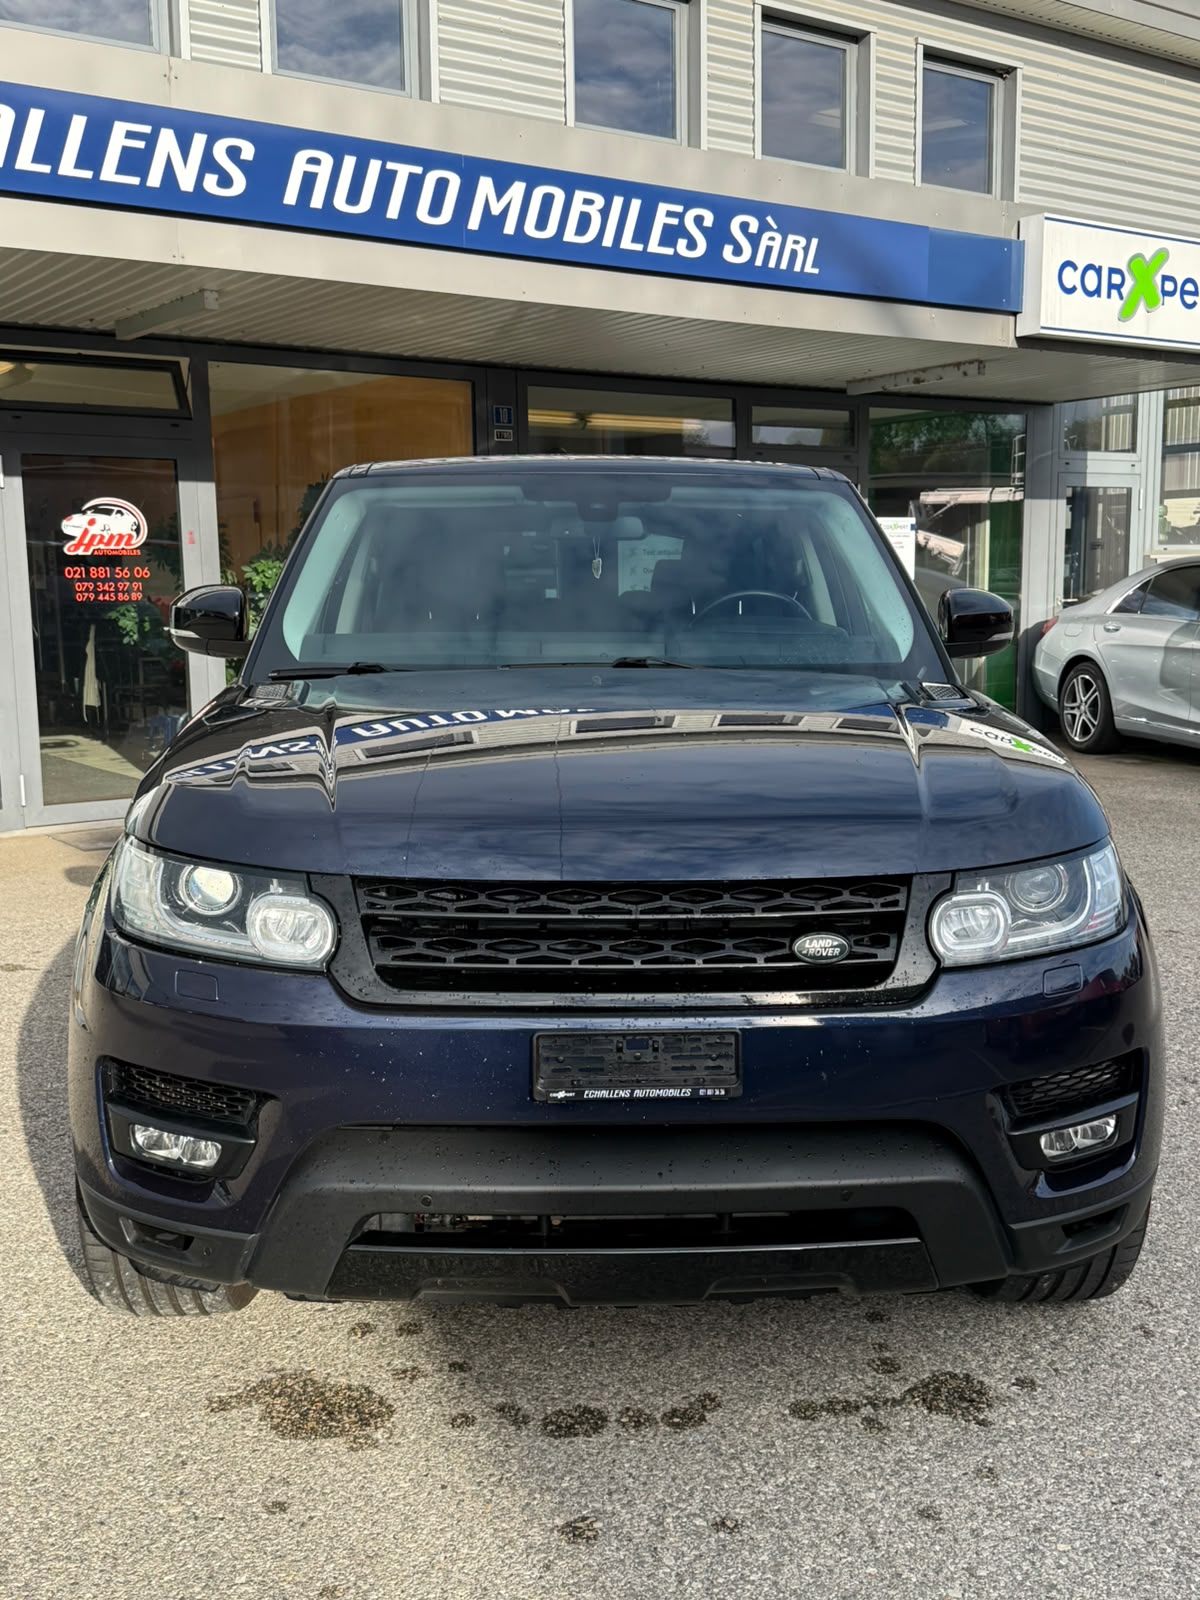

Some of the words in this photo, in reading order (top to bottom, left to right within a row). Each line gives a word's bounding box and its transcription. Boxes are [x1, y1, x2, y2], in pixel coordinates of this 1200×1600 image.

[64, 567, 86, 579] 021
[89, 567, 110, 579] 881
[114, 567, 130, 579] 56
[134, 567, 150, 579] 06
[75, 582, 94, 592] 079
[96, 582, 115, 592] 342
[117, 582, 130, 592] 97
[132, 582, 143, 592] 91
[76, 592, 95, 602] 079
[98, 592, 116, 602] 445
[117, 592, 129, 602] 86
[131, 592, 143, 602] 89
[805, 939, 833, 948] LAND
[807, 947, 841, 957] ROVER
[583, 1089, 631, 1099] ECHALLENS
[634, 1088, 692, 1098] AUTOMOBILES
